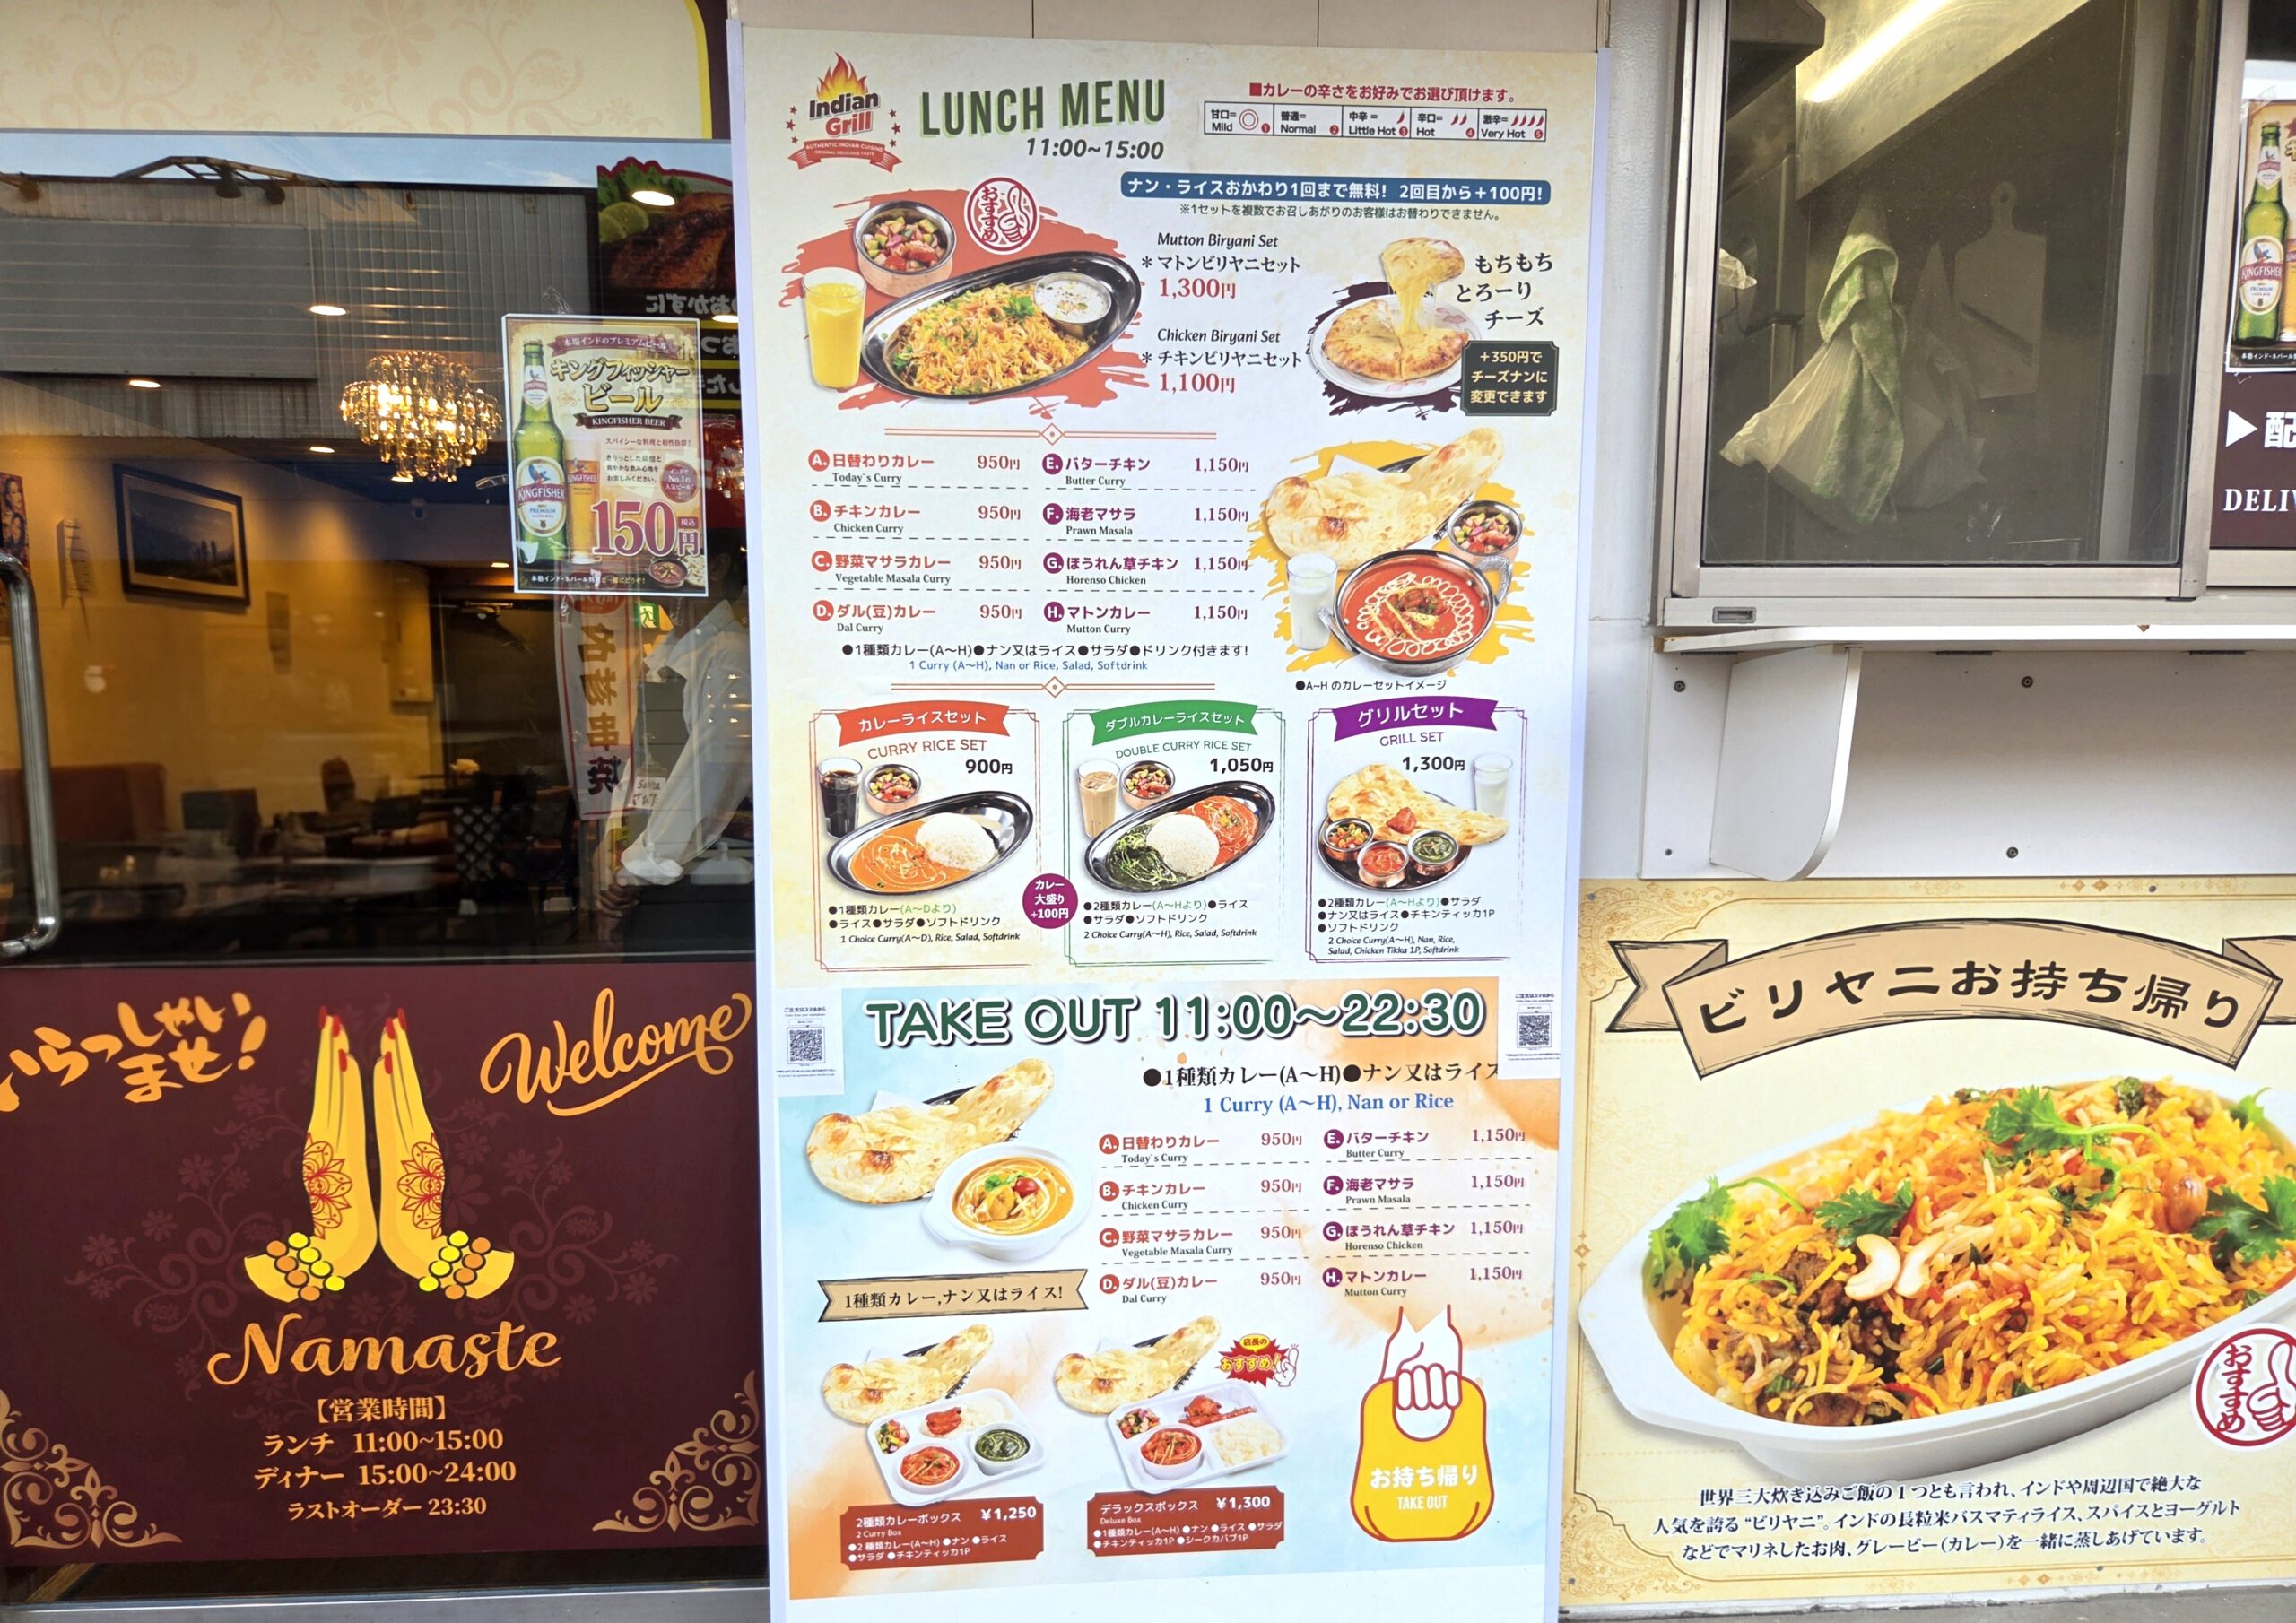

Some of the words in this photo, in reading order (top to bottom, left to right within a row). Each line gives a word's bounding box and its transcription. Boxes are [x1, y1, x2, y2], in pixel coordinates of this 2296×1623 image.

[809, 93, 879, 118] Indian
[919, 86, 1044, 136] LUNCH
[1061, 79, 1164, 126] MENU
[825, 111, 872, 135] Grill
[1212, 122, 1232, 132] Mild
[1281, 125, 1316, 134] Normal
[1349, 126, 1374, 135] Little
[1378, 126, 1396, 135] Hot
[1417, 127, 1435, 136] Hot
[1482, 129, 1504, 140] Very
[1507, 130, 1525, 138] Hot
[981, 186, 998, 242] おすすめ
[1158, 233, 1205, 247] Mutton
[1208, 233, 1255, 249] Biryani
[1258, 235, 1278, 247] Set
[1158, 255, 1300, 273] マトンビリヤニセット
[1476, 253, 1553, 274] もちもち
[2241, 267, 2283, 280] KINGFISHER
[1159, 278, 1236, 299] 1,300円
[1457, 282, 1531, 303] とろーり
[1486, 308, 1544, 329] チーズ
[1158, 329, 1206, 342] Chicken
[1210, 329, 1257, 346] Biryani
[1261, 331, 1281, 343] Set
[1158, 352, 1302, 367] チキンビリヤニセット
[550, 360, 691, 382] キングフィッシャー
[1472, 370, 1548, 383] チーズナンに
[1159, 374, 1236, 395] 1,100円
[583, 384, 663, 412] ビール
[1472, 390, 1548, 404] 変更できます
[592, 417, 642, 426] KINGFISHER
[644, 418, 665, 426] BEER
[832, 454, 934, 469] 日替わりカレー
[978, 455, 1020, 471] 950円
[1065, 457, 1151, 472] バターチキン
[1195, 457, 1249, 473] 1,150円
[874, 472, 902, 484] Curry
[1065, 476, 1095, 486] Butter
[1098, 476, 1126, 489] Curry
[517, 488, 565, 501] KINGFISHER
[2223, 489, 2296, 511] DELI
[834, 505, 920, 519] チキンカレー
[978, 506, 1021, 521] 950円
[1065, 507, 1136, 522] 海老マサラ
[1194, 508, 1248, 523] 1,150円
[834, 523, 874, 534] Chicken
[876, 524, 903, 534] Curry
[1065, 525, 1095, 536] Prawn
[1100, 525, 1133, 536] Masala
[835, 555, 951, 570] 野菜マサラカレー
[979, 555, 1022, 571] 950円
[1066, 556, 1178, 571] ほうれん草チキン
[1194, 556, 1248, 572] 1,150円
[835, 573, 883, 586] Vegetable
[886, 573, 921, 584] Masala
[923, 574, 951, 586] Curry
[1066, 575, 1105, 586] Horenso
[1109, 575, 1146, 586] Chicken
[837, 604, 935, 621] ダル(豆)カレー
[980, 604, 1022, 620] 950円
[1067, 605, 1151, 621] マトンカレー
[1194, 605, 1248, 621] 1,150円
[837, 623, 852, 633] Dal
[855, 624, 883, 635] Curry
[1066, 624, 1100, 634] Mutton
[1104, 625, 1131, 636] Curry
[919, 660, 950, 673] Curry
[996, 660, 1016, 670] Nan
[1019, 662, 1031, 670] or
[1033, 660, 1058, 672] Rice,
[1062, 660, 1094, 672] Salad,
[1097, 660, 1148, 671] Softdrink
[858, 710, 987, 733] カレーライスセット
[1105, 712, 1245, 732] ダブルカレーライスセット
[1358, 702, 1463, 727] グリルセット
[1379, 733, 1416, 747] GRILL
[1420, 732, 1444, 742] SET
[867, 742, 918, 759] CURRY
[922, 741, 955, 753] RICE
[960, 739, 987, 751] SET
[1115, 742, 1161, 759] DOUBLE
[1163, 740, 1200, 753] CURRY
[1204, 741, 1229, 750] RICE
[1231, 742, 1252, 752] SET
[965, 759, 1013, 775] 900円
[1210, 757, 1274, 774] 1,050円
[1402, 757, 1465, 772] 1,300円
[1035, 880, 1065, 890] カレー
[1034, 893, 1065, 906] 大盛り
[1328, 947, 1352, 956] Salad,
[1354, 946, 1385, 955] Chicken
[1387, 946, 1407, 954] Tikka
[1410, 946, 1422, 955] 1P,
[1423, 945, 1459, 955] Softdrink
[1700, 959, 2245, 1034] ビリヤニお持ち帰り
[865, 999, 1009, 1044] TAKE
[1024, 997, 1135, 1039] OUT
[480, 987, 752, 1116] Welcome
[1220, 1097, 1273, 1116] Curry
[1348, 1095, 1385, 1111] Nan
[1389, 1098, 1410, 1110] or
[1414, 1094, 1454, 1109] Rice
[1122, 1134, 1219, 1150] 日替わりカレー
[1261, 1133, 1302, 1147] 950円
[1346, 1130, 1429, 1144] バターチキン
[1472, 1128, 1526, 1143] 1,150円
[1122, 1182, 1205, 1196] チキンカレー
[1345, 1176, 1413, 1192] 海老マサラ
[206, 1313, 561, 1385] Namaste
[2217, 1343, 2252, 1434] おすすめ
[264, 1433, 335, 1456] ランチ
[254, 1465, 344, 1489] ディナー
[1370, 1464, 1478, 1489] お持ち帰り
[288, 1497, 422, 1520] ラストオーダー
[428, 1497, 486, 1515] 23:30
[1100, 1500, 1198, 1515] デラックスボックス
[1397, 1497, 1424, 1510] TAKE
[1427, 1496, 1448, 1509] OUT
[864, 1531, 885, 1539] Curry
